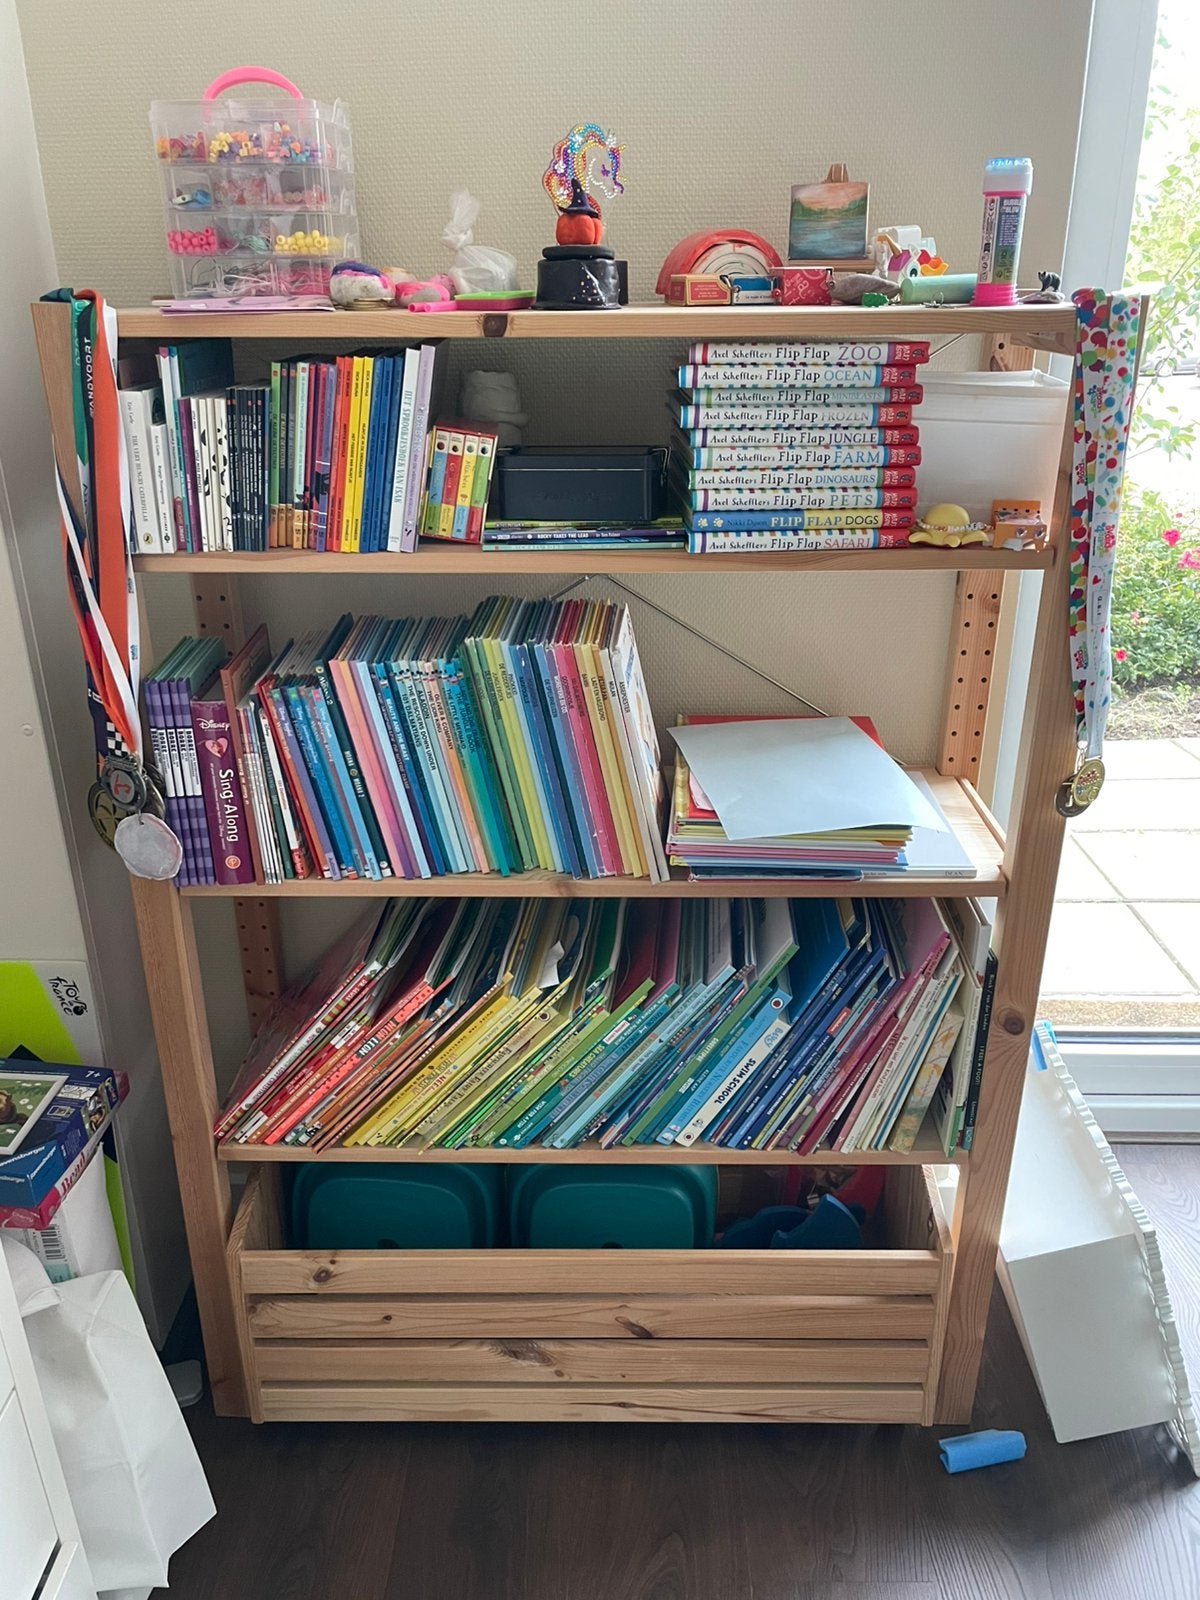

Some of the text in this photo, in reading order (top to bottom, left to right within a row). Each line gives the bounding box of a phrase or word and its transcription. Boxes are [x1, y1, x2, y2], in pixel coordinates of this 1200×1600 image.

[710, 346, 882, 361] Axel Flip Flap ZOO
[701, 367, 872, 383] Axel Flip Flap OCEAN
[714, 389, 882, 404] Axel Flip Flap MINIBEASTS
[703, 409, 869, 423] Axel Flip Flap FROZEN
[130, 434, 138, 447] THE
[392, 389, 413, 503] HET SPROOKJESBOEK VAN ISAK
[710, 432, 877, 447] Axel Flip Flap JUNGLE
[132, 447, 140, 462] VERY
[715, 450, 880, 465] Axel Flip Flap FARM
[134, 462, 144, 485] HUNGRY
[698, 473, 876, 487] Axel Flip Flap DINOSAURS
[137, 485, 149, 522] CATERPILLAR
[711, 495, 874, 509] Axel Flip Flap PETS
[770, 516, 802, 527] FLIP
[807, 516, 842, 527] FLAP
[845, 515, 880, 526] DOGS
[709, 538, 871, 551] Axel Flip Flap SAFARI
[425, 689, 434, 702] THE
[444, 688, 453, 700] THE
[416, 688, 431, 719] ALADDIN
[429, 702, 439, 717] LION
[448, 701, 459, 721] LITTLE
[196, 717, 230, 732] Disney
[401, 693, 423, 747] 101 DALMATIANS
[405, 684, 437, 771] THE RESCUERS DOWN UNDER
[432, 692, 445, 716] OLIVER
[440, 721, 455, 750] COMPANY
[454, 692, 476, 754] THE JUNGLE BOOK
[384, 697, 410, 761] BEAUTY AND THE BEAST
[158, 731, 167, 753] BORRE
[168, 730, 176, 752] BORRE
[178, 730, 186, 751] BORRE
[185, 730, 194, 752] BORRE
[216, 768, 241, 842] Sing-Along
[357, 1019, 397, 1057] NEON LEON
[568, 1042, 605, 1079] SEA CREATURES
[85, 1070, 101, 1079] 7+
[712, 1056, 757, 1106] SWIM SCHOOL
[534, 1098, 546, 1110] WISH
[527, 1108, 537, 1118] FOR
[516, 1118, 526, 1129] FISH
